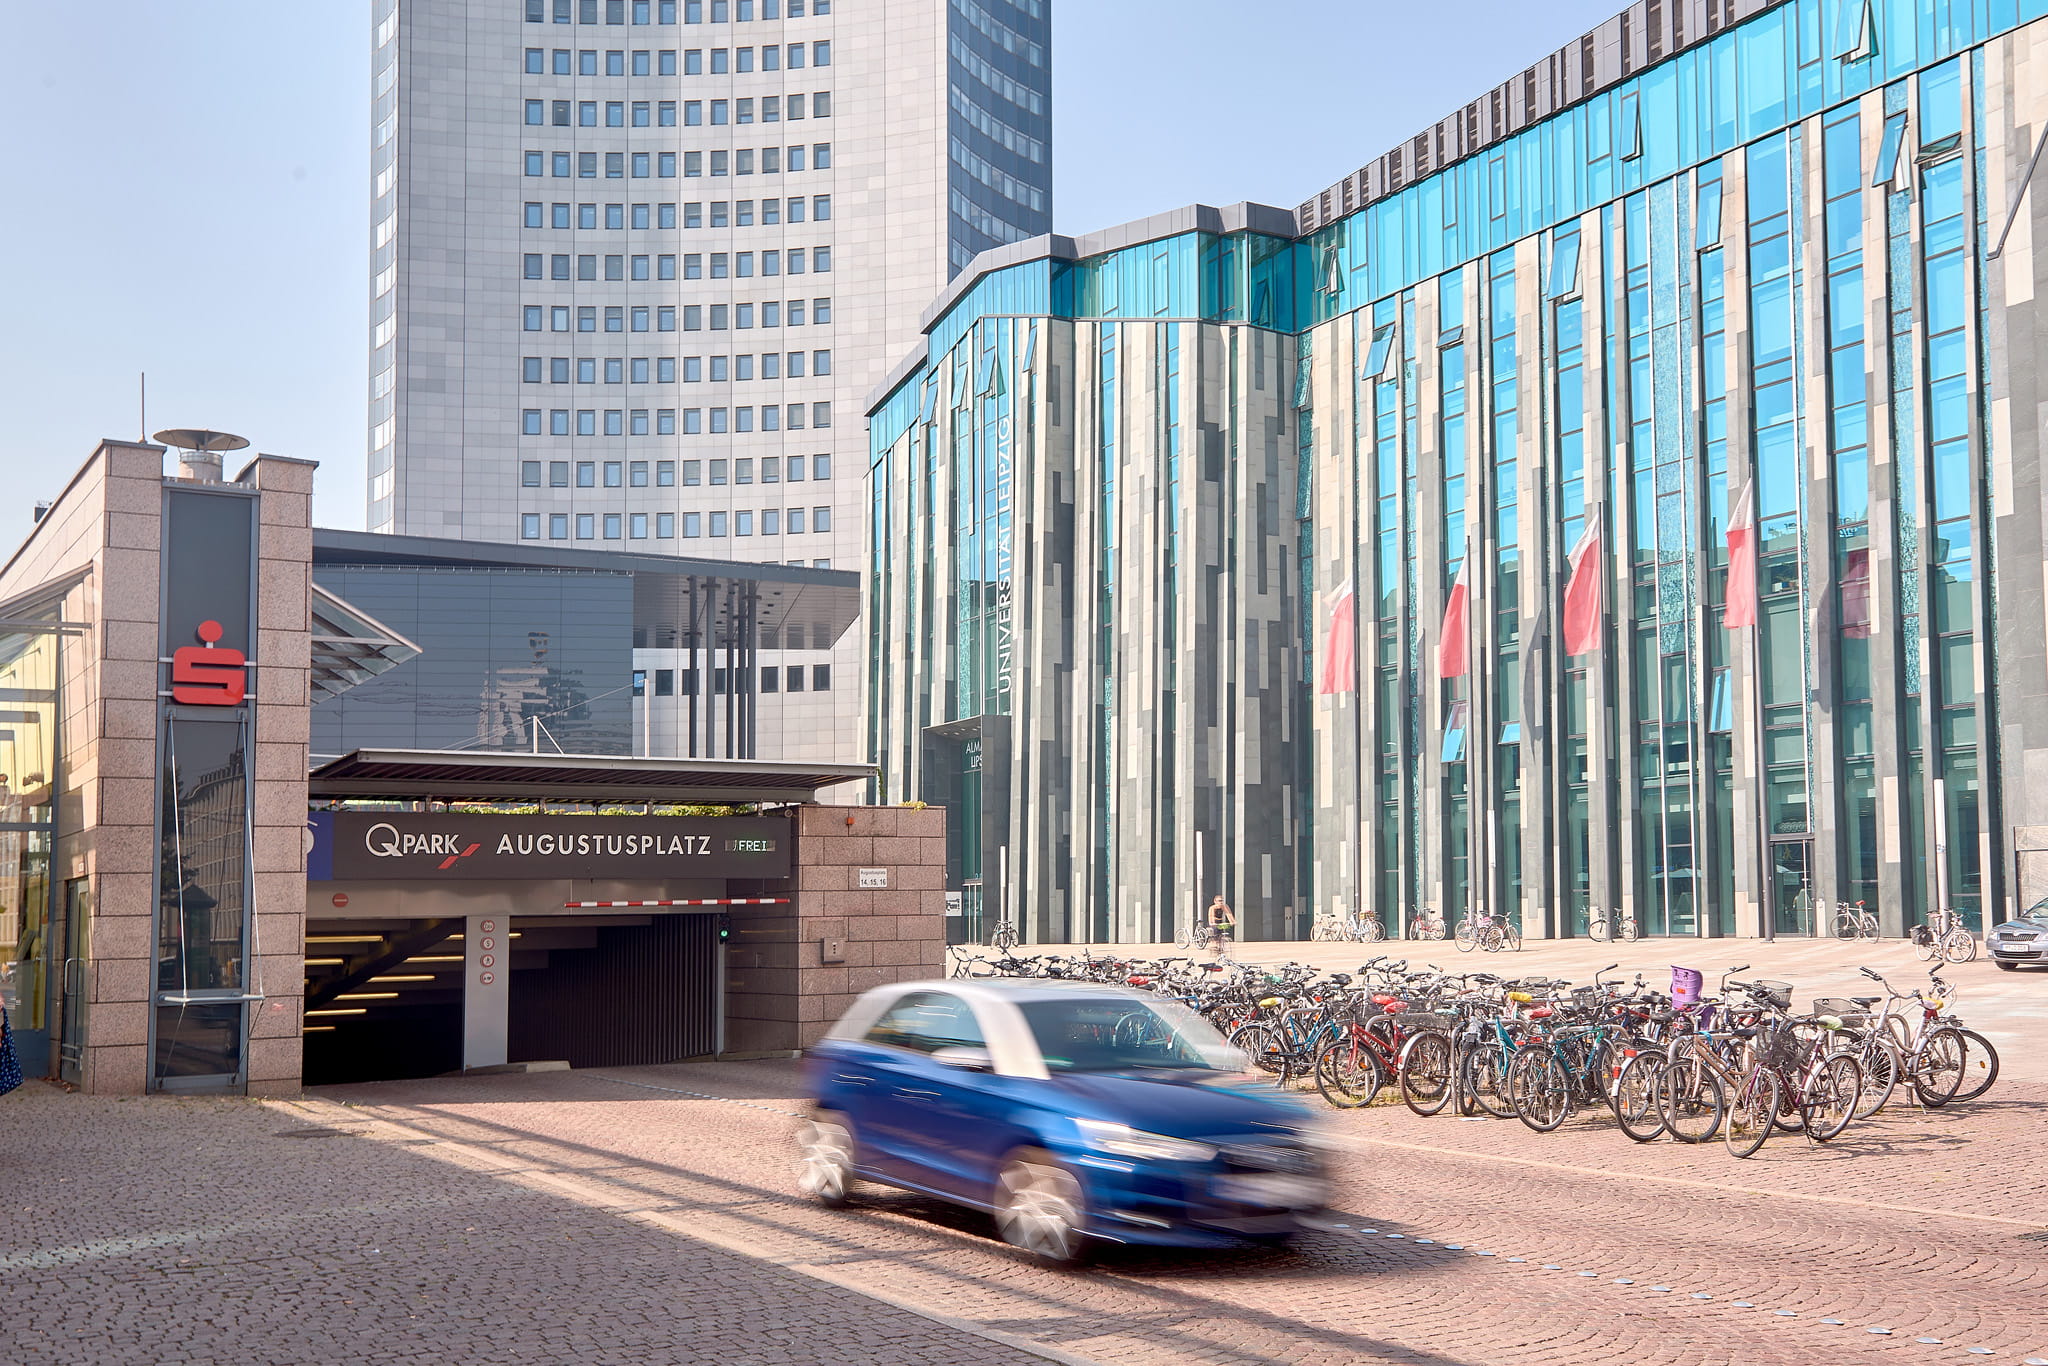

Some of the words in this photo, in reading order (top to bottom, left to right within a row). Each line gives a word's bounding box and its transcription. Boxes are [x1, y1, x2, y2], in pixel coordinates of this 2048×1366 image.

[998, 417, 1011, 513] LEIPZIG
[998, 525, 1011, 694] UNIVERSITÄT
[965, 740, 982, 754] ALM
[495, 833, 712, 855] AUGUSTUSPLATZ
[738, 840, 767, 852] FREI
